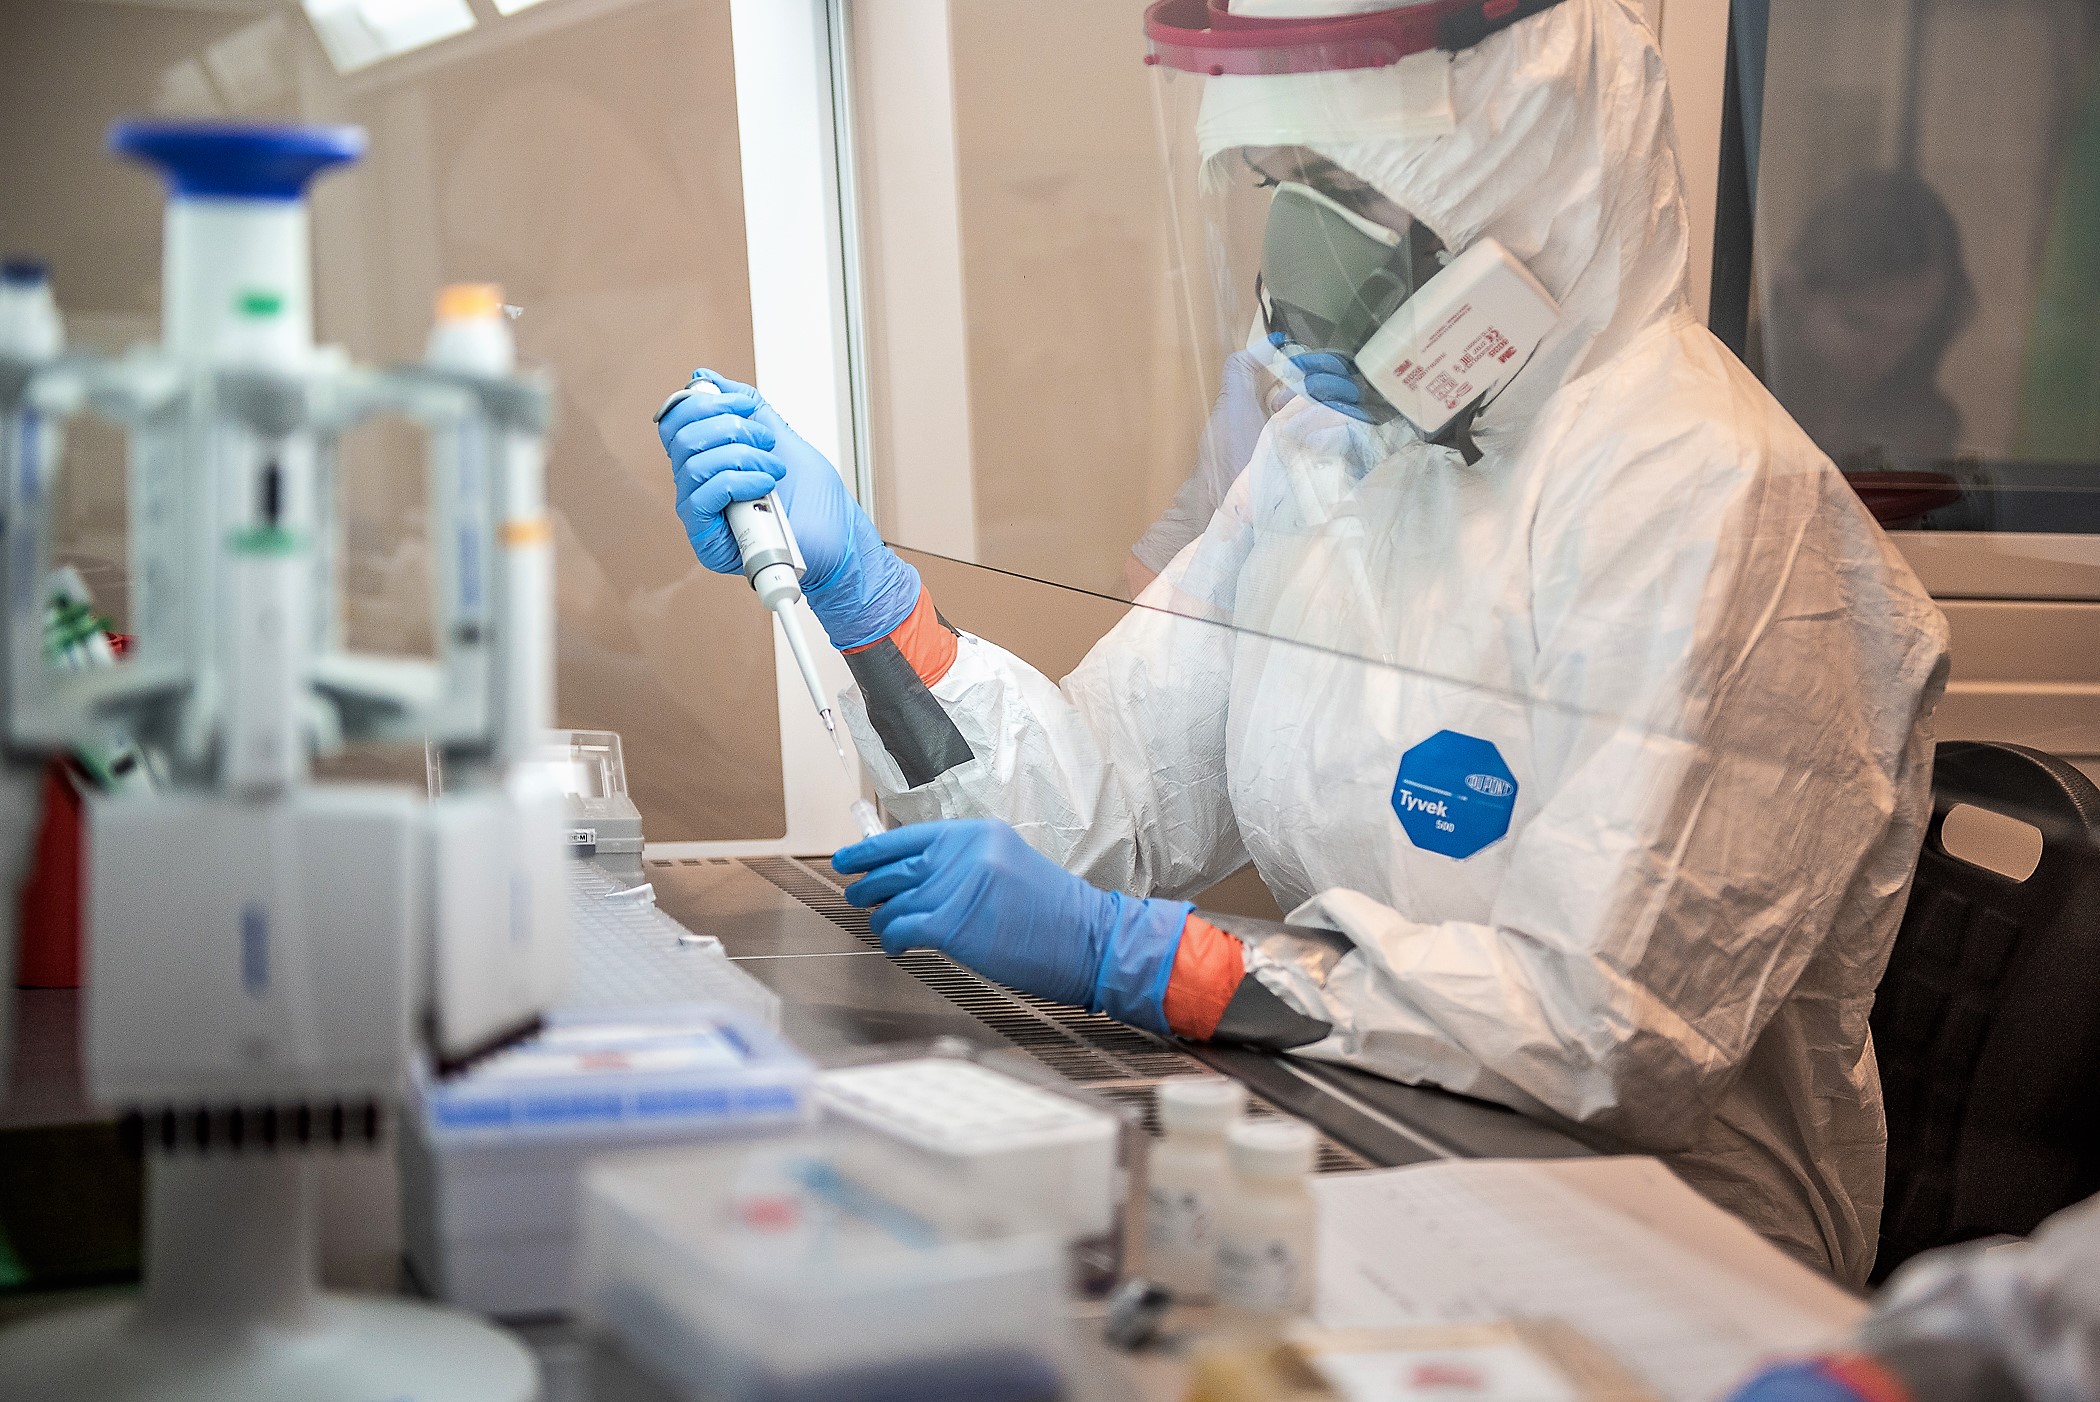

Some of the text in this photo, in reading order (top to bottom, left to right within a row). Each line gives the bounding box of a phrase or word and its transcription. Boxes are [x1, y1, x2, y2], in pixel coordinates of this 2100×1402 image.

[1498, 346, 1517, 364] 3M
[1400, 789, 1448, 818] Tyvek
[1435, 819, 1455, 833] 500
